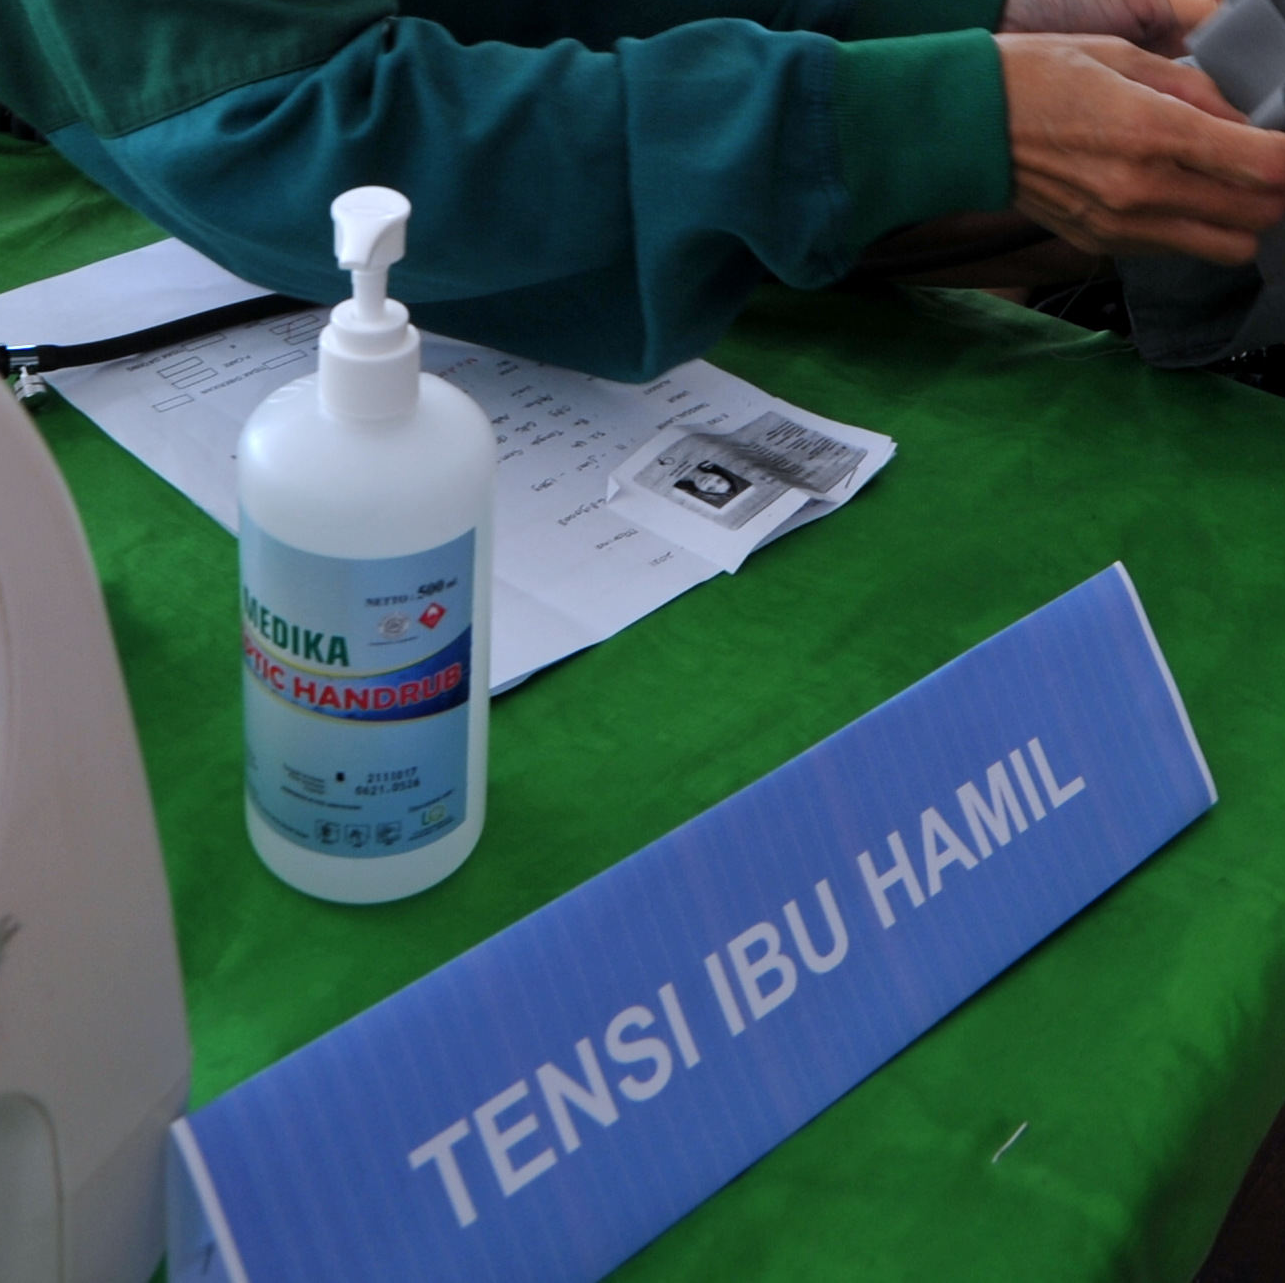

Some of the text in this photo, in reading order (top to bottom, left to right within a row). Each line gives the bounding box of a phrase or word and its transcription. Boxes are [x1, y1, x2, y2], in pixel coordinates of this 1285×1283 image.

[244, 585, 350, 668] MEDIKA
[292, 662, 463, 711] HANDRUB
[408, 735, 1087, 1229] TENSI IBU HAMIL
